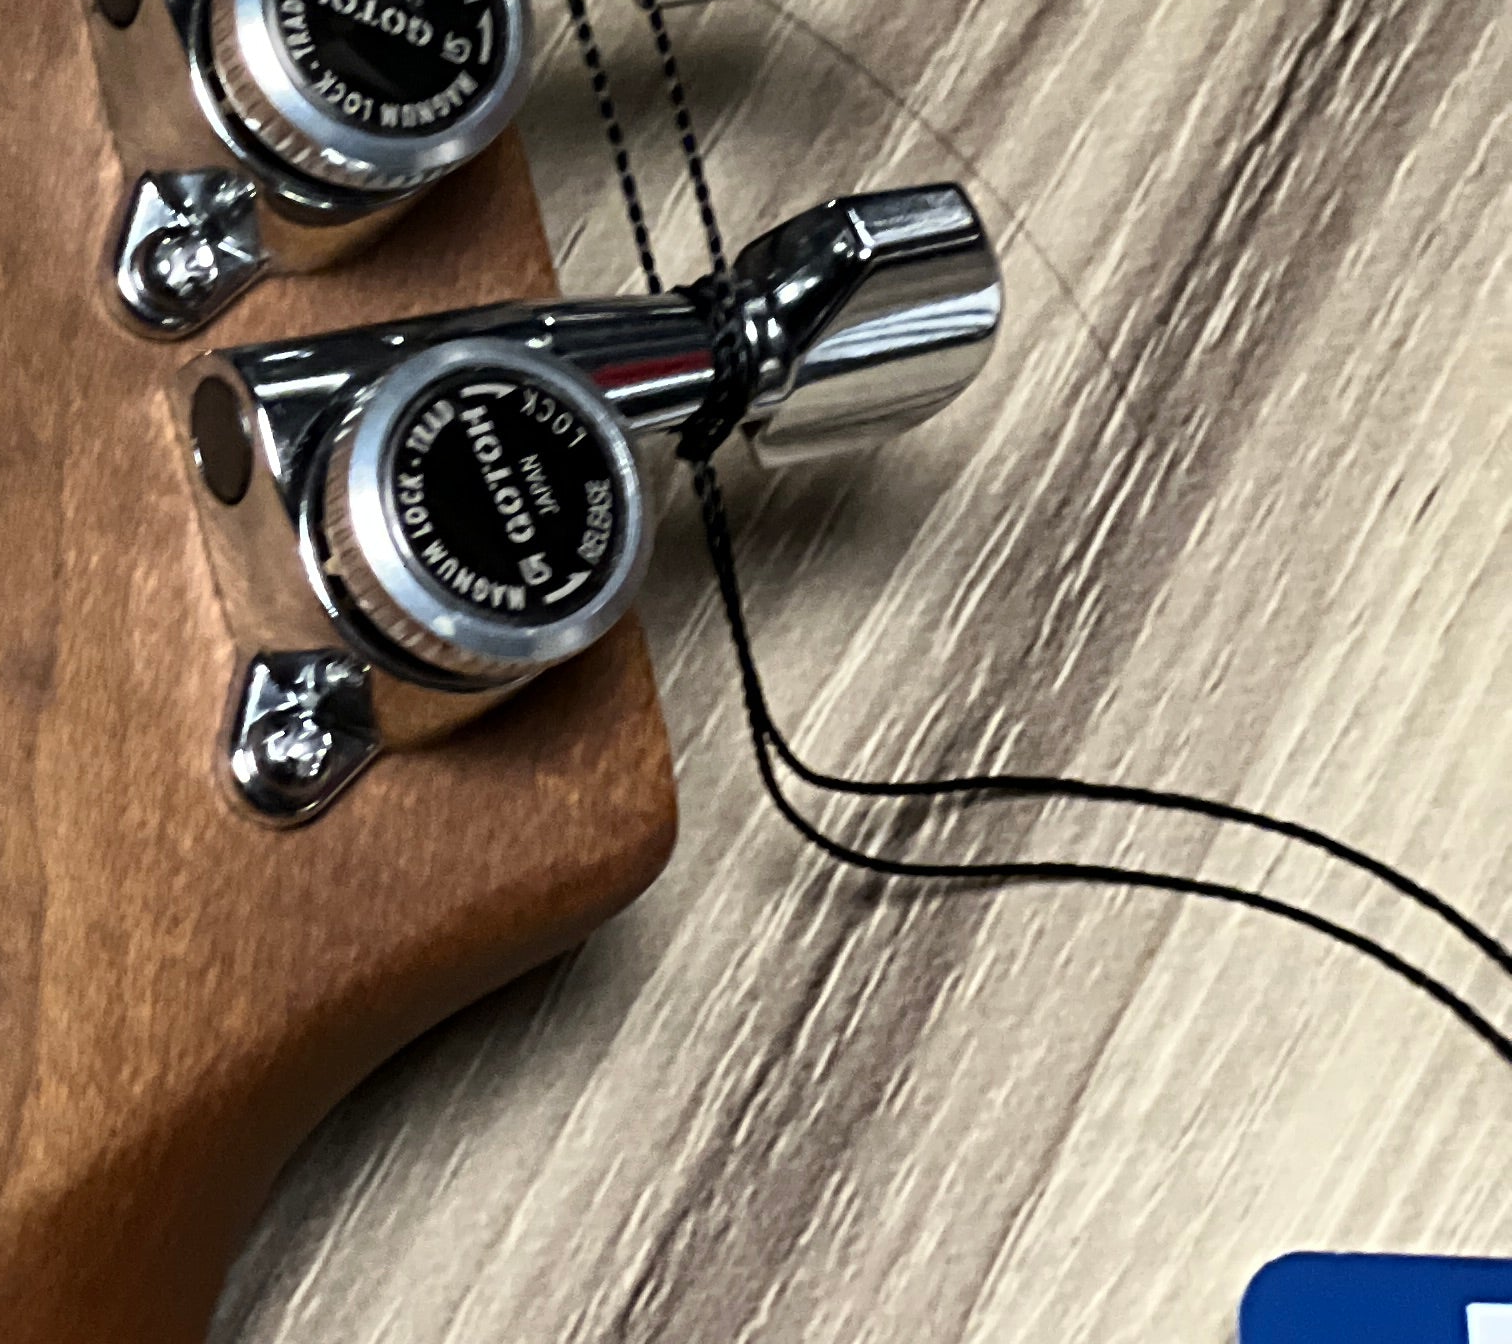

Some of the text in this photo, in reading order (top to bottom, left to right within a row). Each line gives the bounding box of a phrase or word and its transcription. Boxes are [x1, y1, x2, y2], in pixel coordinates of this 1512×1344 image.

[313, 69, 374, 122] LOCK
[520, 388, 588, 448] LOCK
[398, 473, 434, 539] LOCK
[459, 405, 536, 543] GOTOH
[519, 453, 560, 515] JAPAN
[422, 538, 526, 610] MAGNUM
